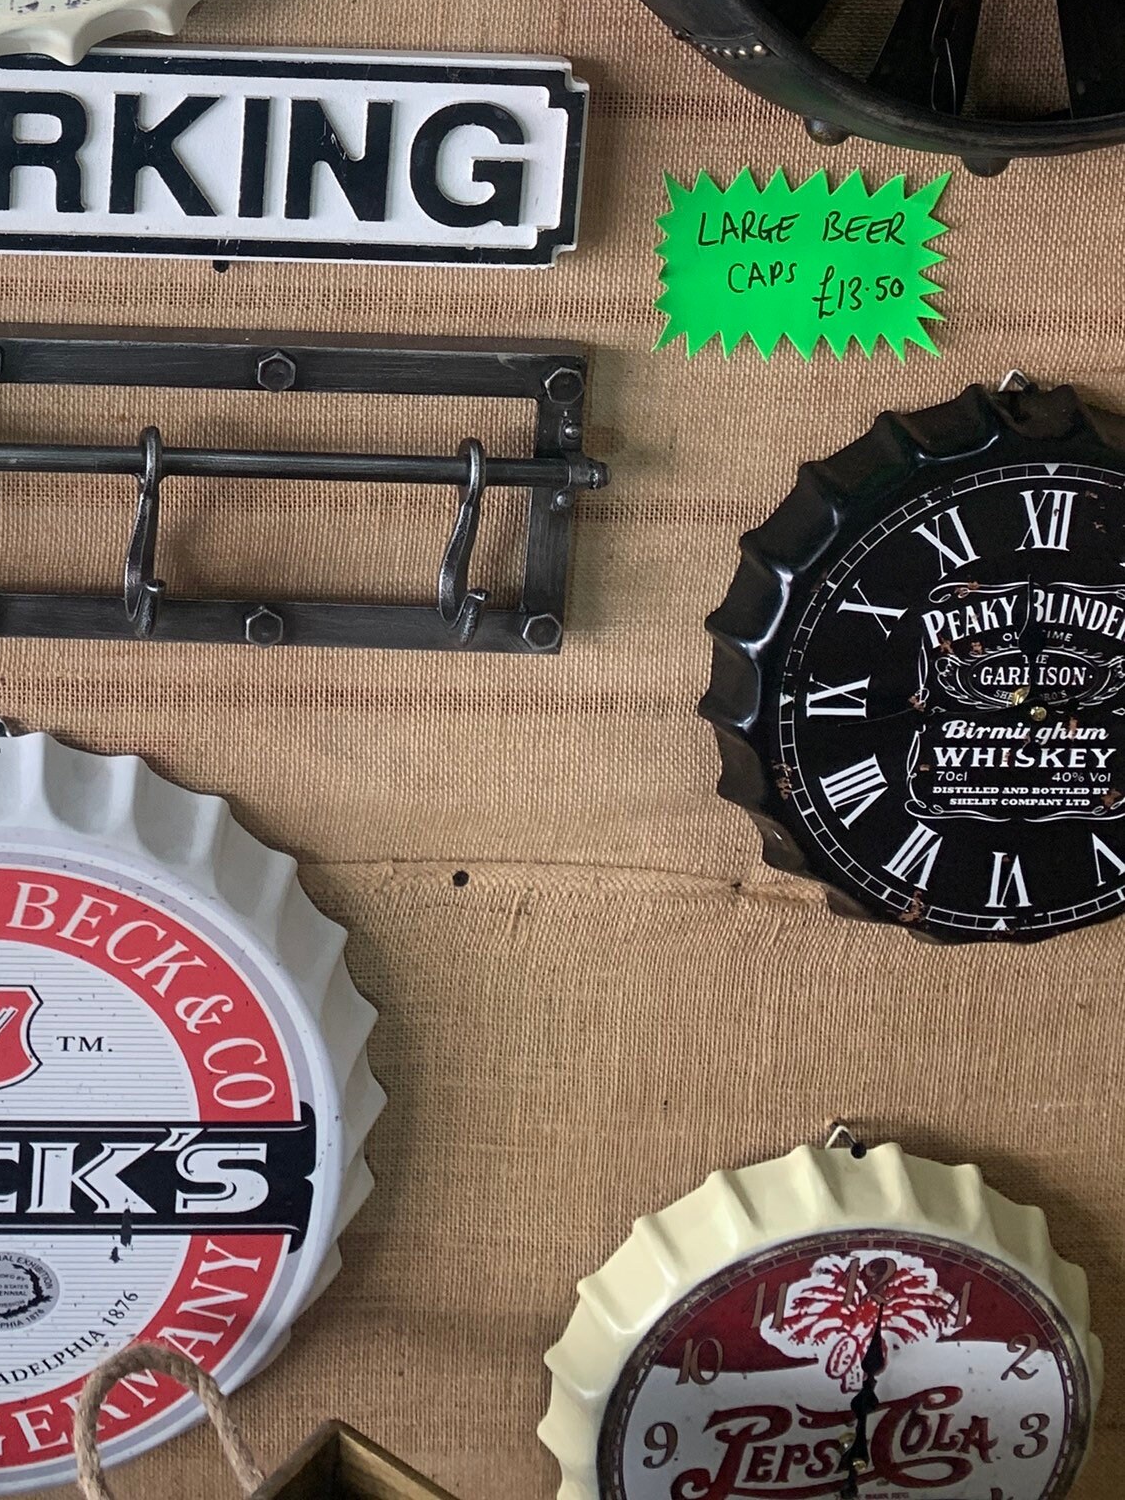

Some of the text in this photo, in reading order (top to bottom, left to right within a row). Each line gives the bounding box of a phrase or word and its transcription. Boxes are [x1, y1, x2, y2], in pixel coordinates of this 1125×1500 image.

[697, 210, 906, 246] LARGE BEER
[727, 260, 798, 293] CAPS
[1016, 489, 1078, 552] XII
[911, 505, 981, 581] XI
[837, 578, 909, 640] X
[921, 594, 1019, 649] PEAKY
[1041, 629, 1074, 643] IME
[806, 672, 872, 719] IX
[941, 719, 1110, 746] Birmigham
[933, 746, 1117, 768] WHISKEY
[936, 771, 1111, 783] 70cl 40% Vol
[932, 786, 1110, 795] DISTILLED AND BOTTLED BY
[949, 798, 1091, 806] SHELBY COMPANY LTD
[7, 880, 209, 999] BECK
[174, 992, 235, 1034] &
[56, 1034, 114, 1054] TM.
[202, 1036, 276, 1109] CO
[16, 1256, 53, 1290] EXHIBITION
[101, 1289, 140, 1328] 1876
[675, 1337, 726, 1386] 10
[1001, 1333, 1053, 1381] 2
[642, 1420, 679, 1470] 9
[670, 1404, 873, 1500] PEPS
[1013, 1412, 1051, 1459] 3
